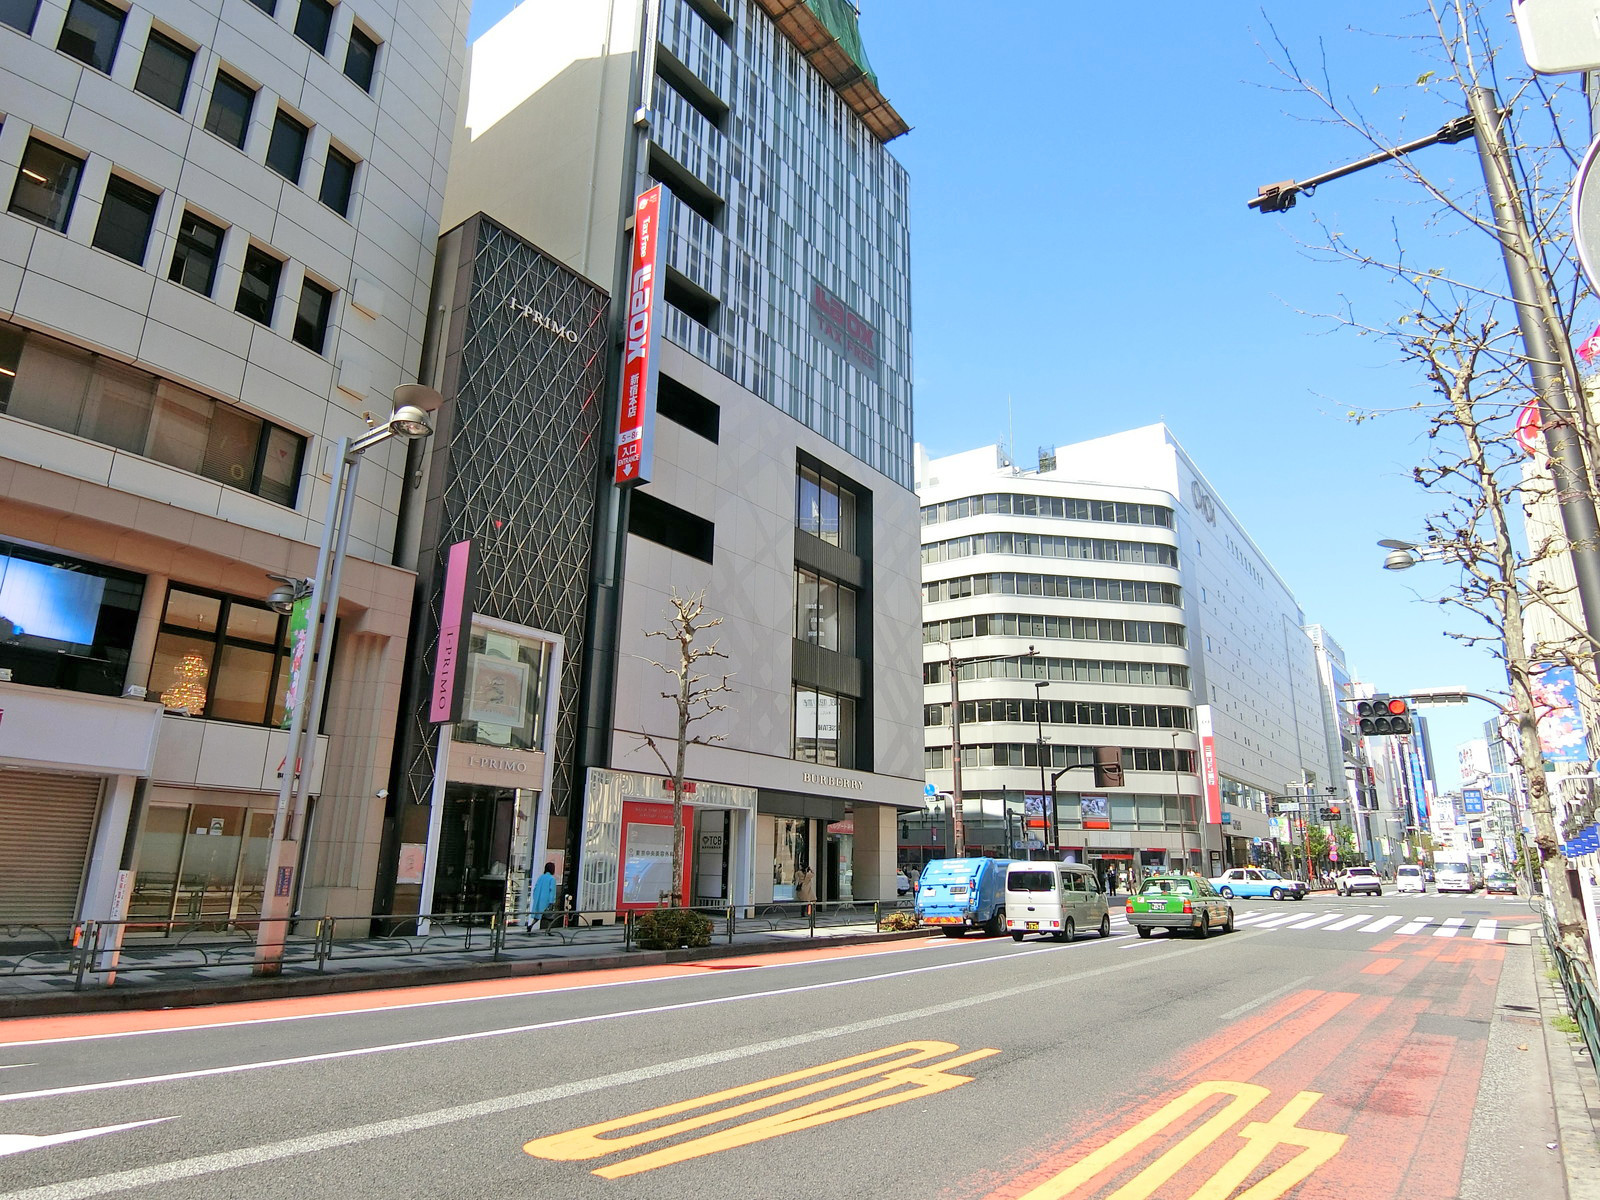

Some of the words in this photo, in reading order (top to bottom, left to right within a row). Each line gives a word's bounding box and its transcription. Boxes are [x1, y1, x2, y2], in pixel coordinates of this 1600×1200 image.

[509, 296, 578, 343] I-PRIMO
[816, 314, 843, 345] TAX
[847, 340, 875, 369] FREE
[627, 373, 640, 418] 新宿本店
[617, 453, 640, 467] ENTRANCE
[621, 444, 637, 458] 入口
[438, 632, 454, 710] I-PRIMO
[468, 756, 527, 772] I-PRIMO
[802, 772, 864, 790] BURBERRY
[709, 835, 722, 846] TCB
